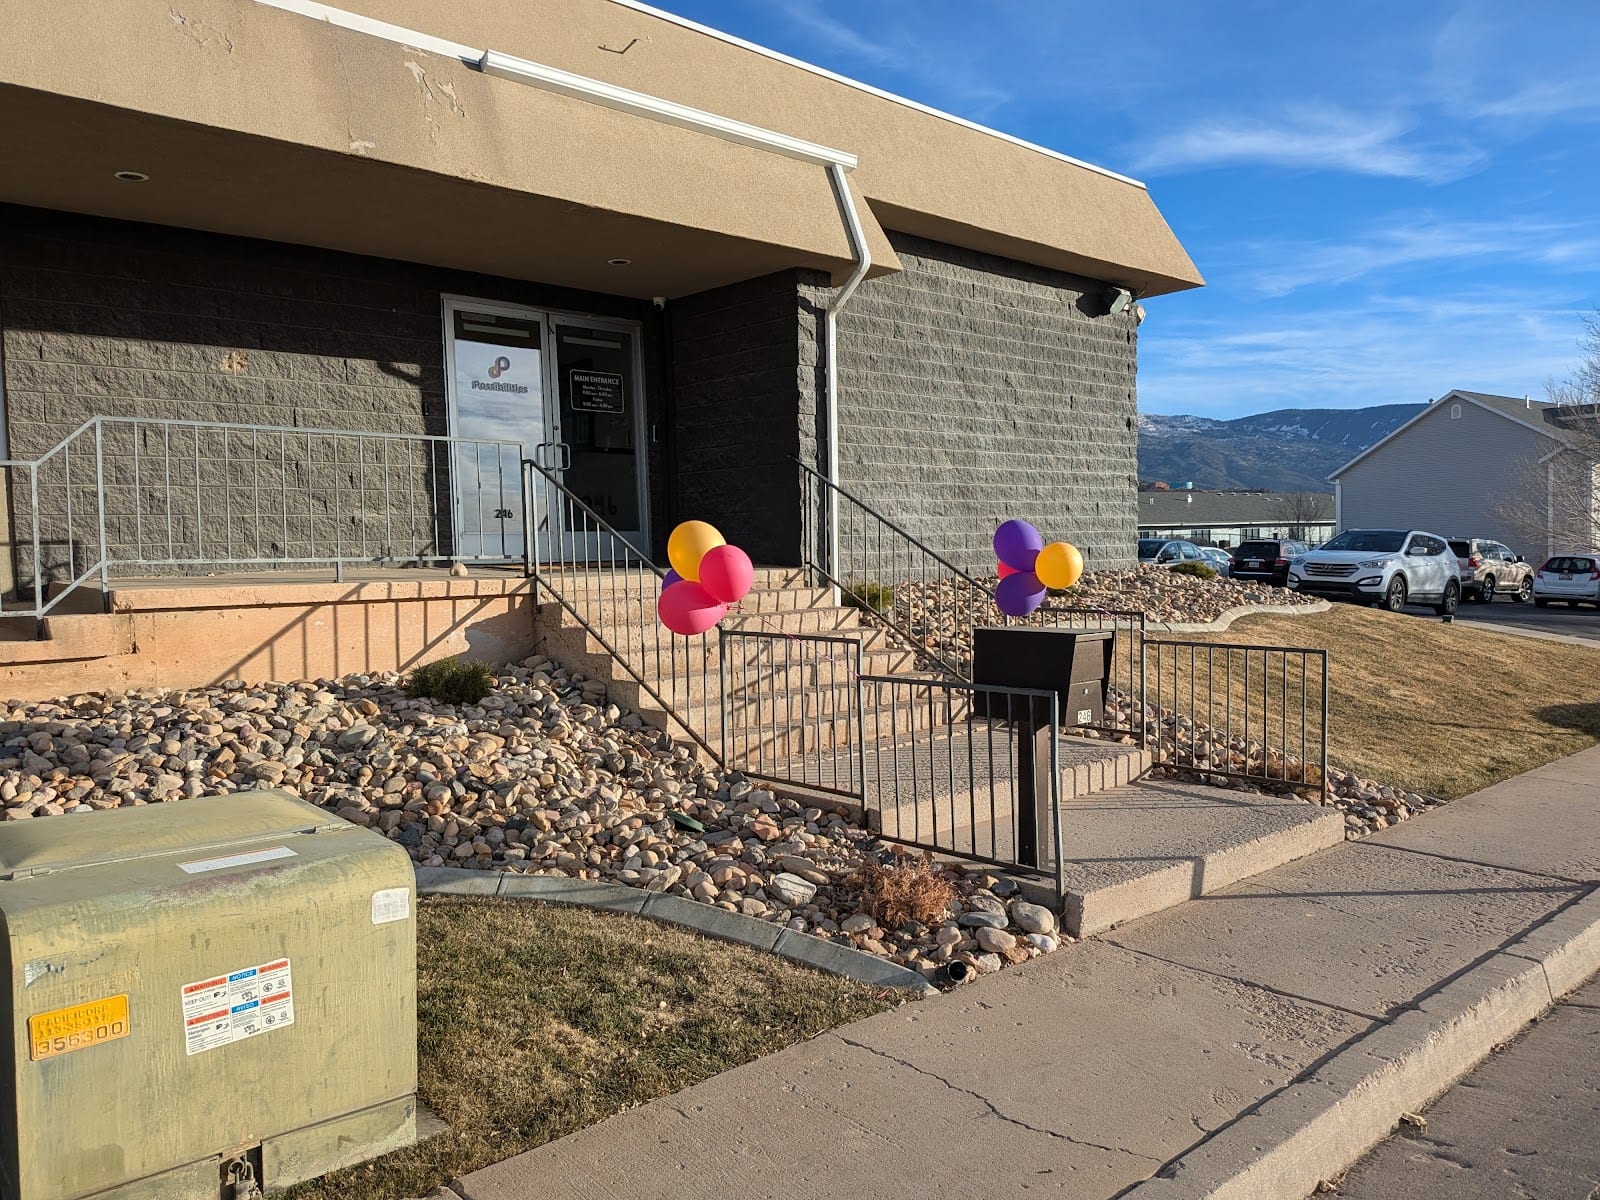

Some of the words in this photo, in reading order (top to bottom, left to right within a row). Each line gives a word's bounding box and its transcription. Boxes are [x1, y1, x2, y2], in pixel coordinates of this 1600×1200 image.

[590, 376, 619, 385] ENTRANCE
[472, 380, 528, 393] Possibilities
[1079, 711, 1090, 722] 246
[232, 971, 254, 980] NOTICE
[236, 1003, 255, 1011] AVISO
[38, 1005, 110, 1028] PACIFICORP
